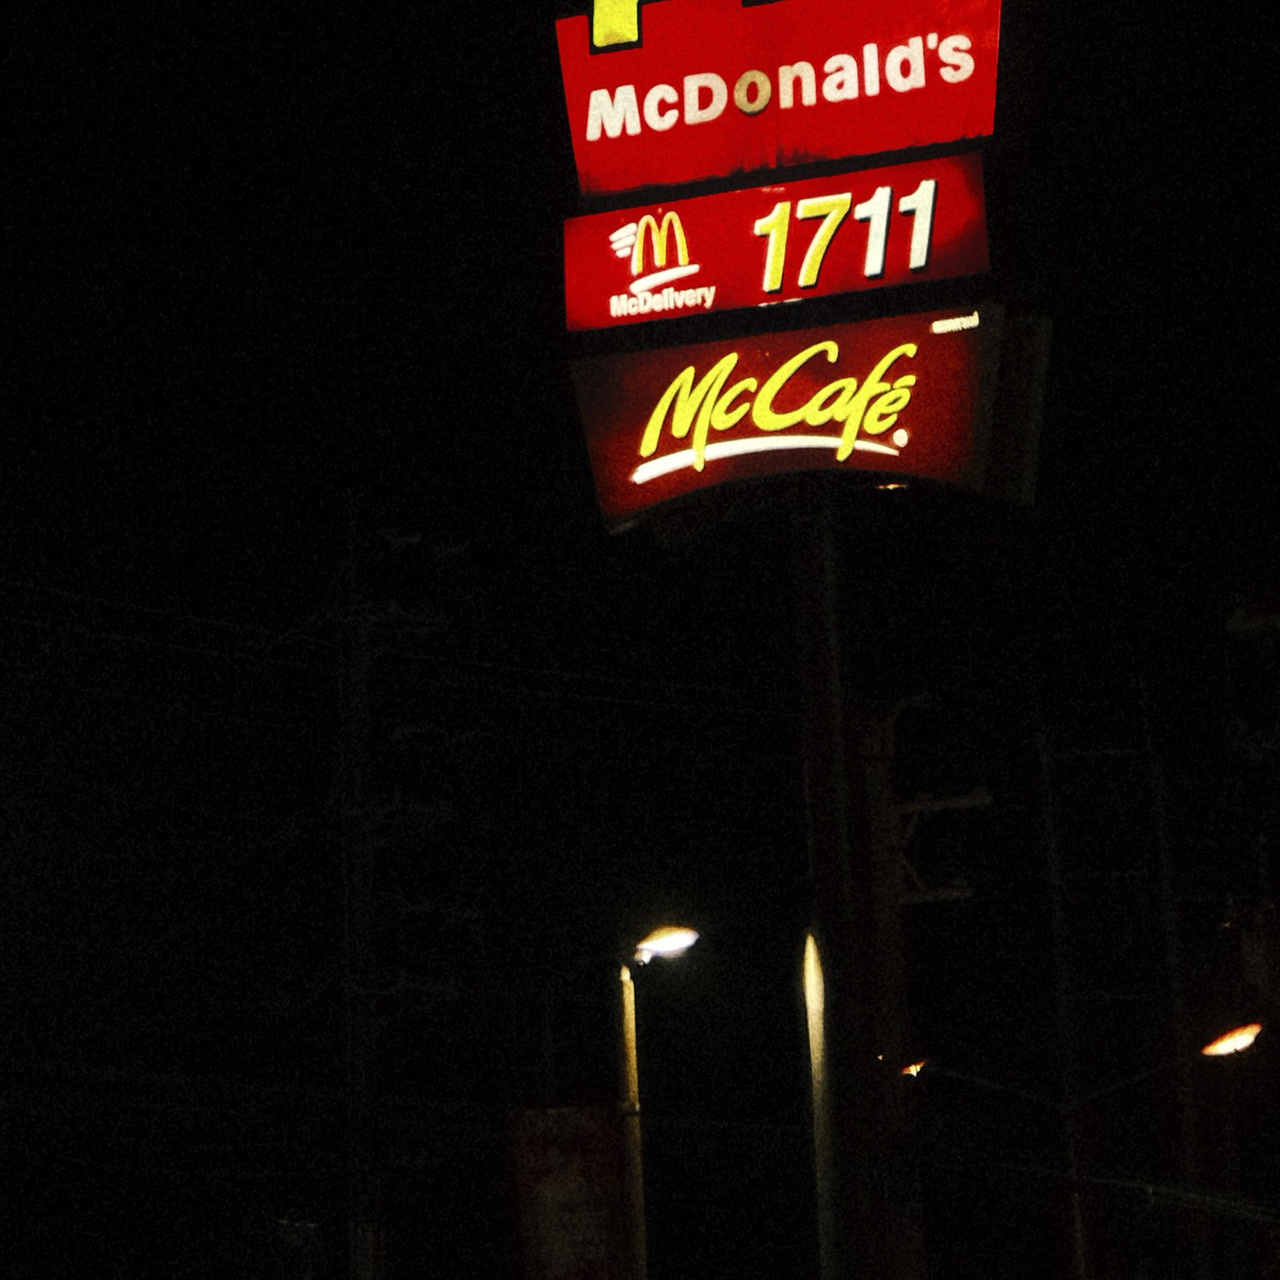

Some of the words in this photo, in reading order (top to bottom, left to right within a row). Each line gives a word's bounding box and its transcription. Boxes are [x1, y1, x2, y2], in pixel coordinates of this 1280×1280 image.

[586, 33, 976, 142] McDonald's
[753, 179, 936, 293] 1711
[609, 286, 716, 317] McDelivery
[639, 340, 918, 472] McCafé
